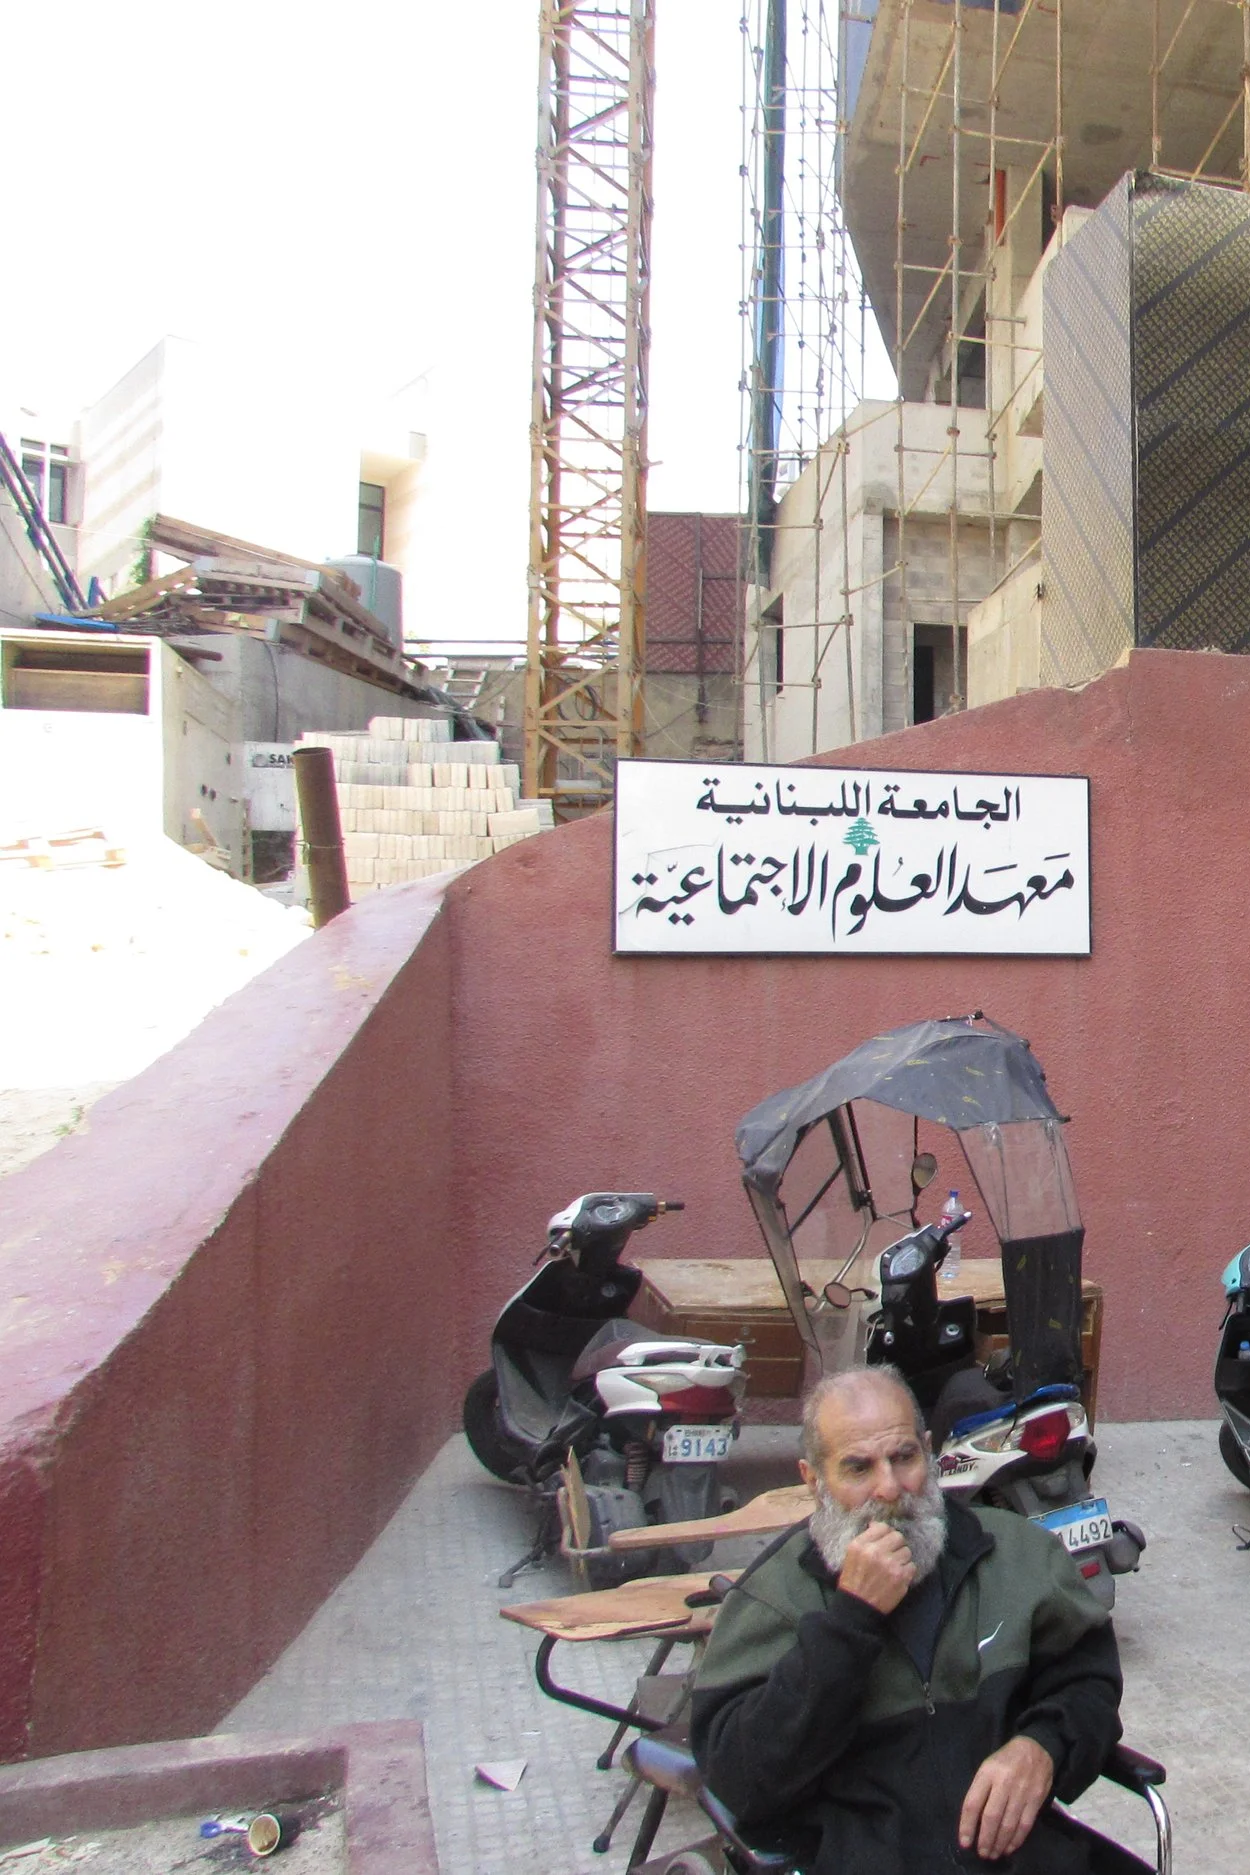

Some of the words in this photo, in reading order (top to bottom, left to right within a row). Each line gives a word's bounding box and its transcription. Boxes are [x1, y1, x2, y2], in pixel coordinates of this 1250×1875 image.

[695, 777, 871, 827] اللبنانية
[877, 783, 1021, 829] الجامعة
[681, 1437, 728, 1457] 9143
